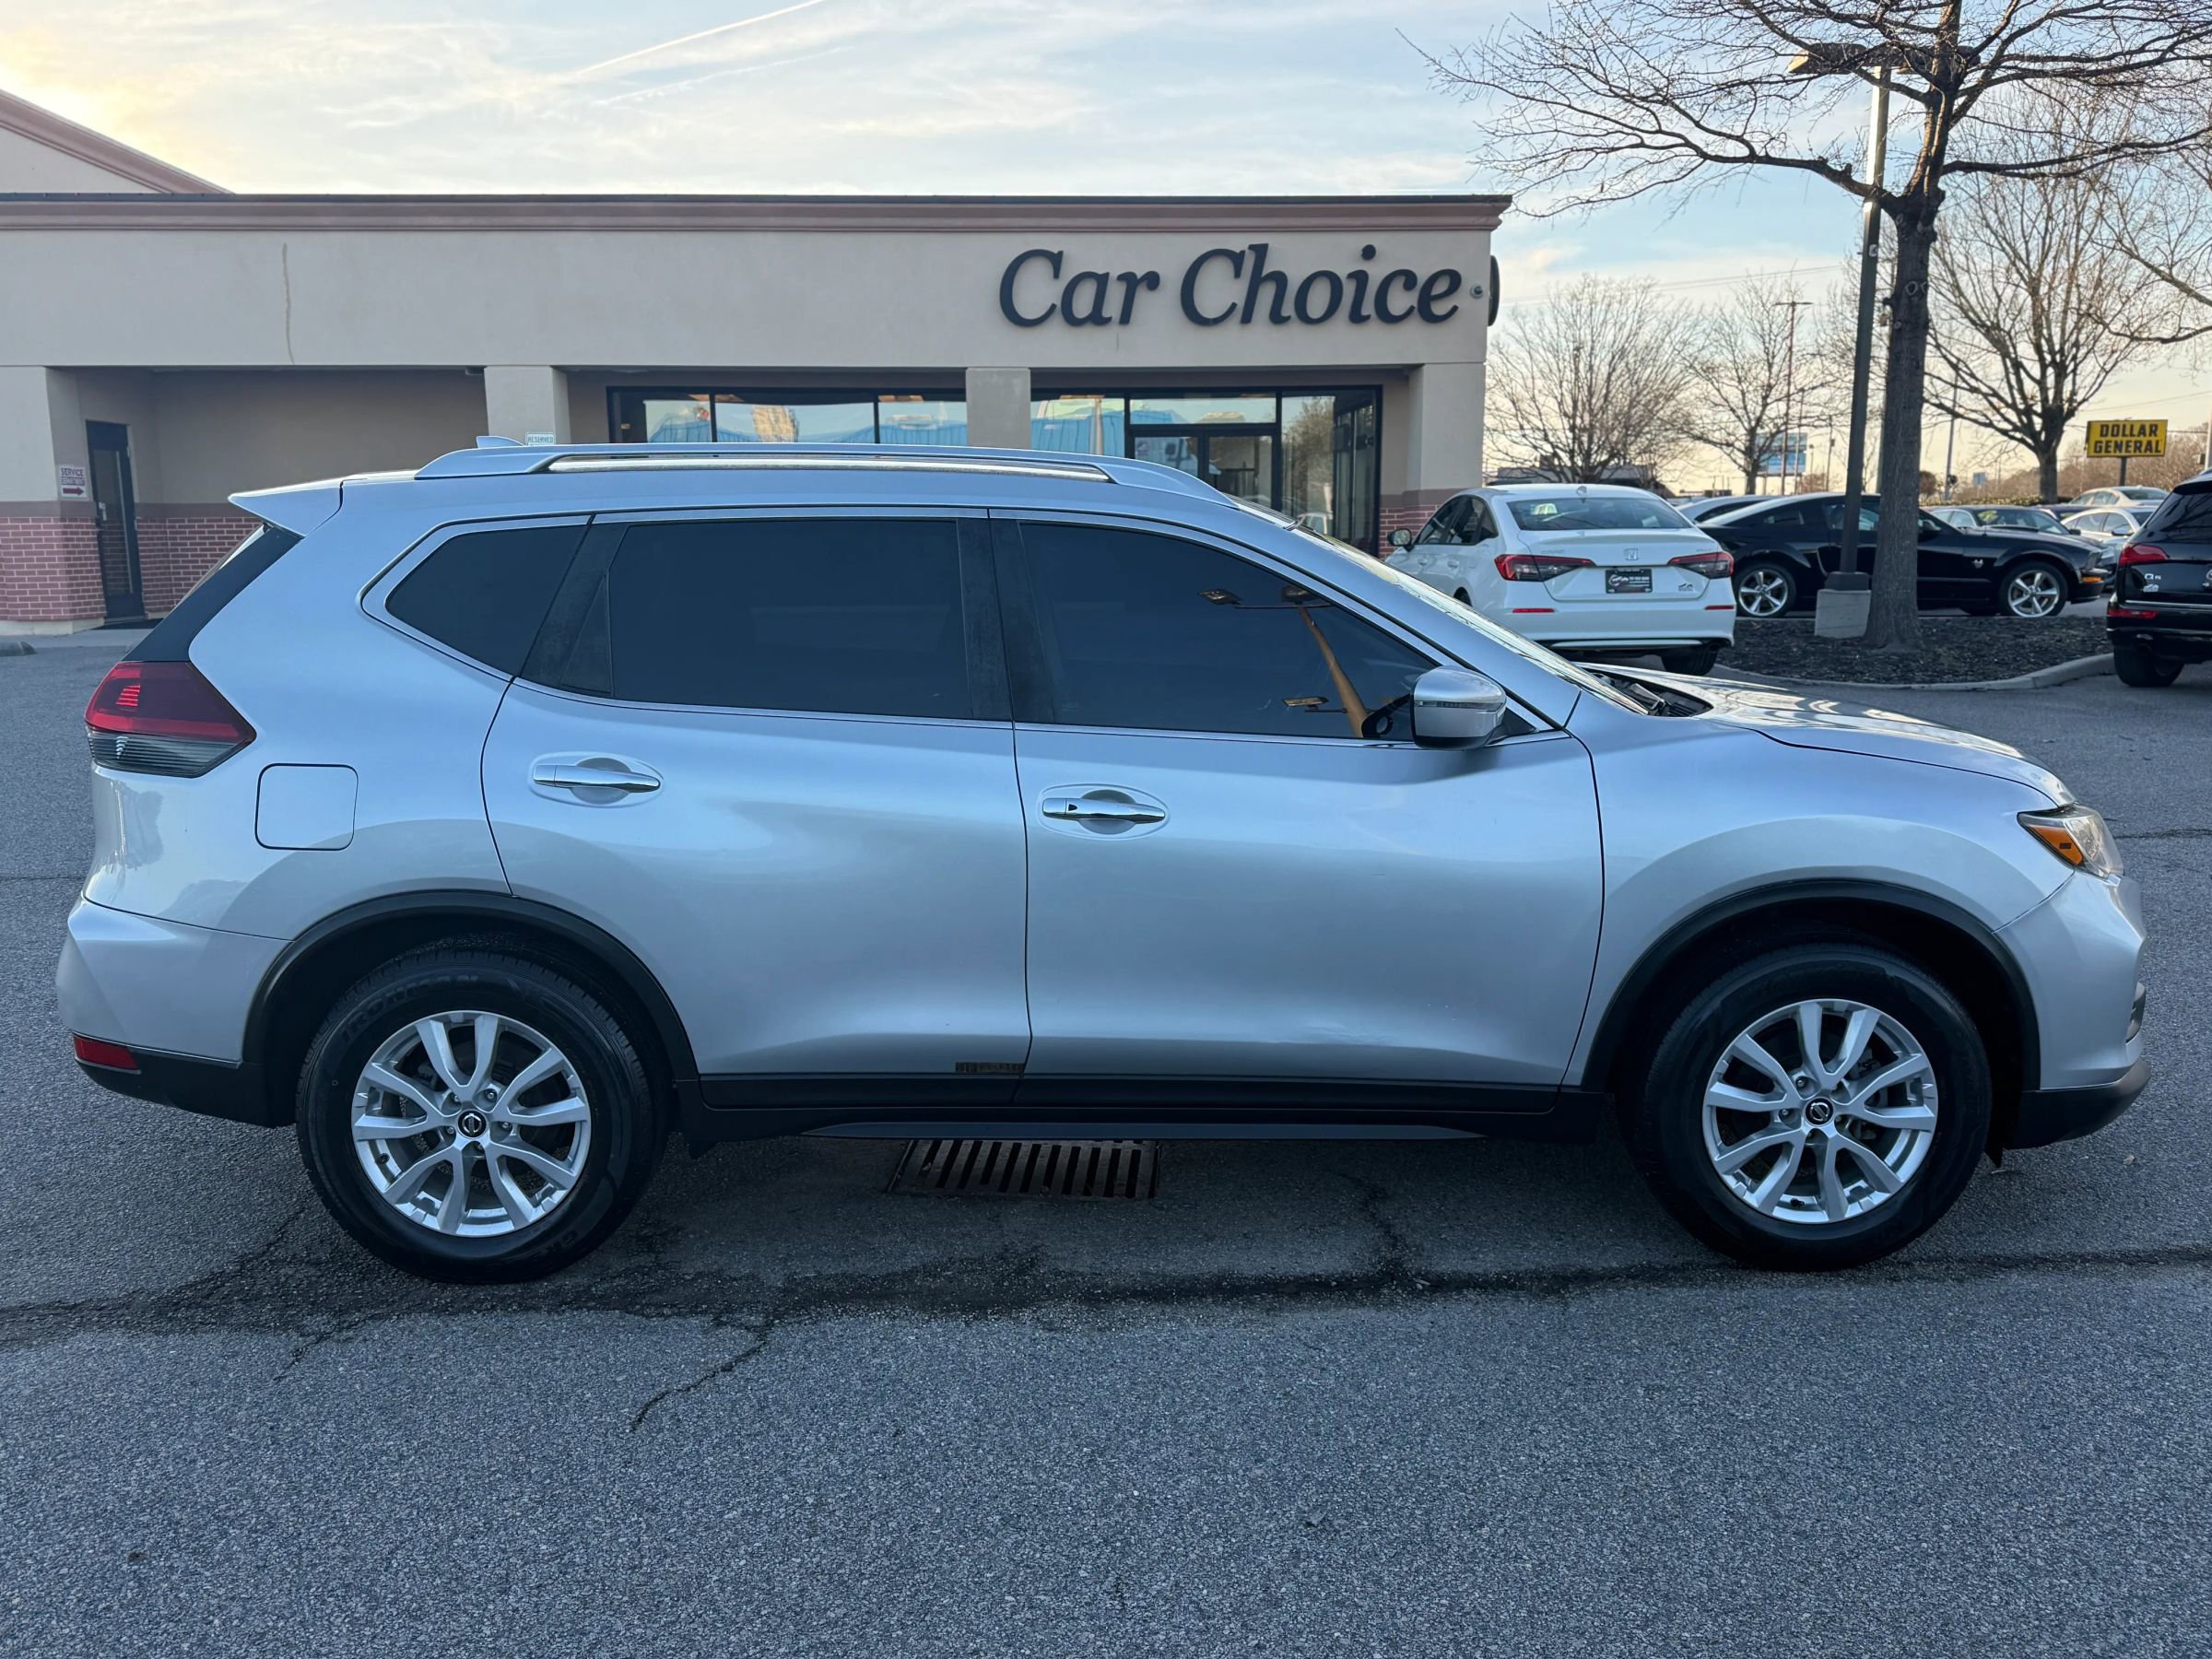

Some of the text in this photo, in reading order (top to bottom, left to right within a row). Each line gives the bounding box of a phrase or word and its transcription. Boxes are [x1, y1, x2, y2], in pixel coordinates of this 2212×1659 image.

[999, 243, 1462, 327] Car Choice
[2100, 423, 2158, 438] DOLLAR
[2094, 440, 2161, 453] GENERAL
[61, 467, 84, 477] SERVICE
